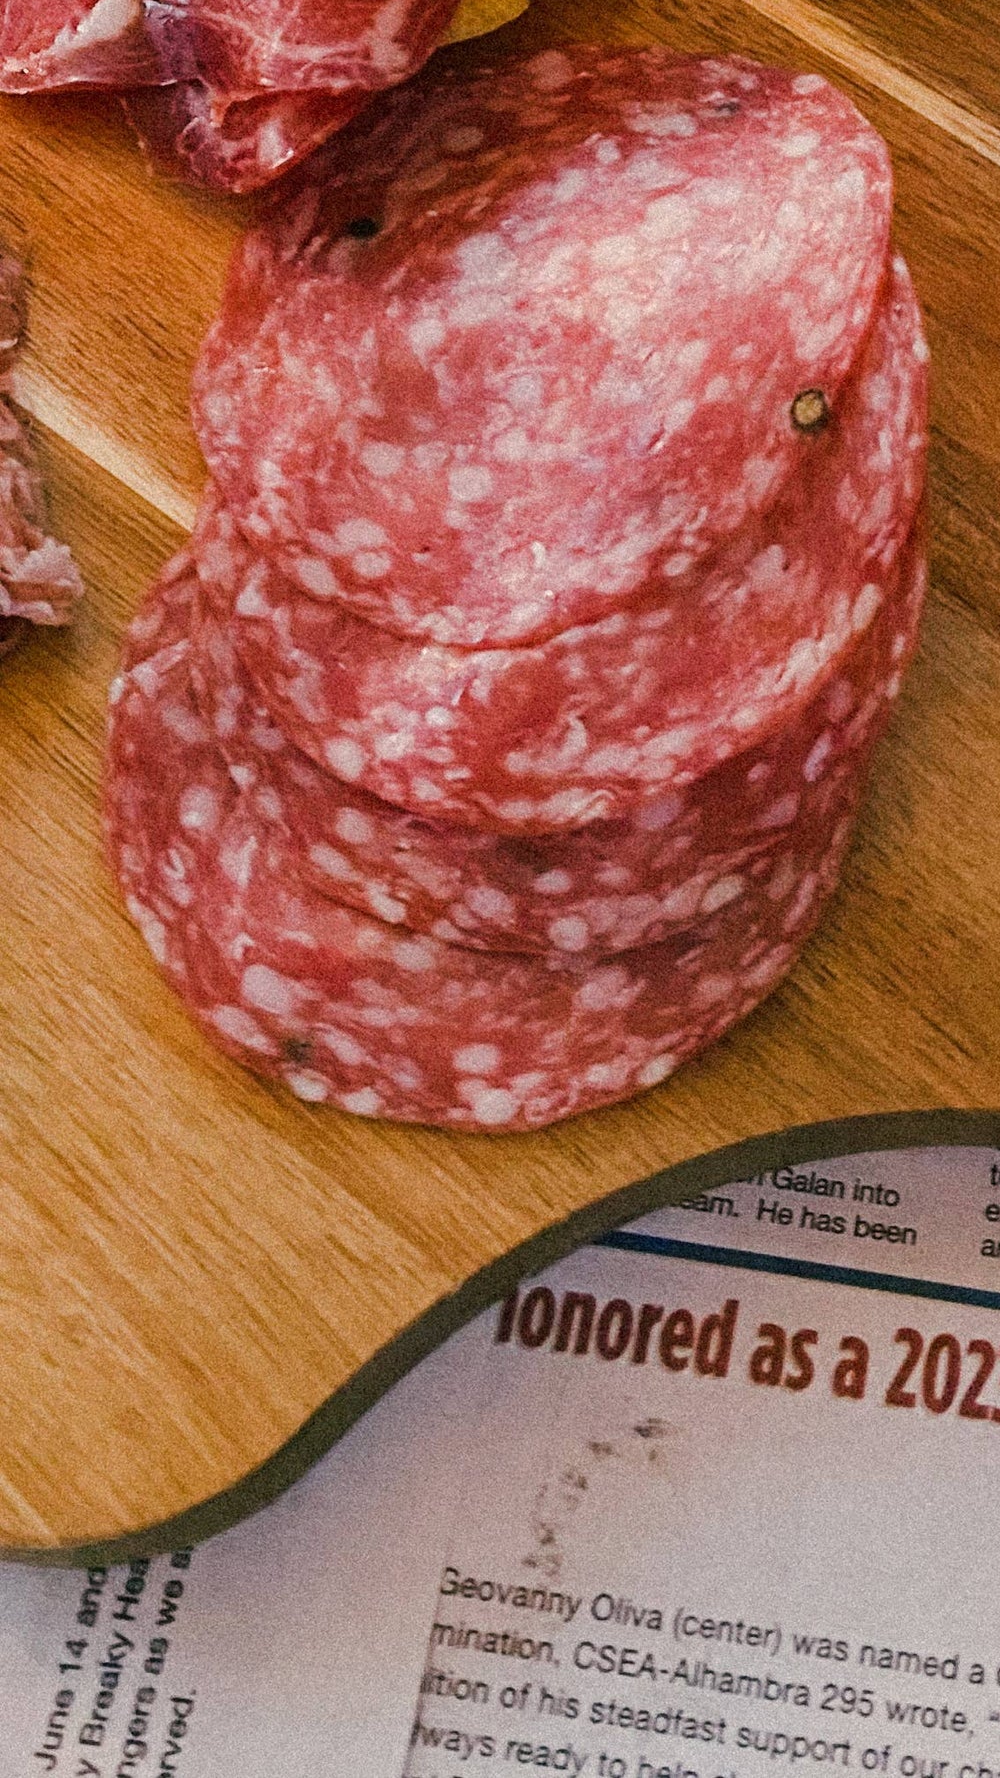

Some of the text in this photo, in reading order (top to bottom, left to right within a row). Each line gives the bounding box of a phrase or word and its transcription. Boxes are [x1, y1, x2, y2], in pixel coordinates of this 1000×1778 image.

[756, 1198, 918, 1245] He has been
[771, 1167, 845, 1200] Galan
[853, 1178, 901, 1208] into
[750, 1321, 820, 1392] as
[832, 1336, 871, 1401] a
[144, 1579, 184, 1675] as we
[440, 1566, 582, 1623] Geovanny
[590, 1593, 663, 1632] Oliva
[672, 1606, 784, 1657] (center)
[792, 1629, 849, 1662] was
[858, 1642, 960, 1682] named
[968, 1663, 986, 1685] a
[34, 1637, 90, 1771] June 14
[78, 1629, 135, 1747] Breaky
[499, 1681, 949, 1778] of his steadfast support of our
[573, 1641, 810, 1708] CSEA-Alhambra
[819, 1683, 875, 1717] 295
[885, 1698, 975, 1737] wrote,
[504, 1736, 627, 1778] ready to
